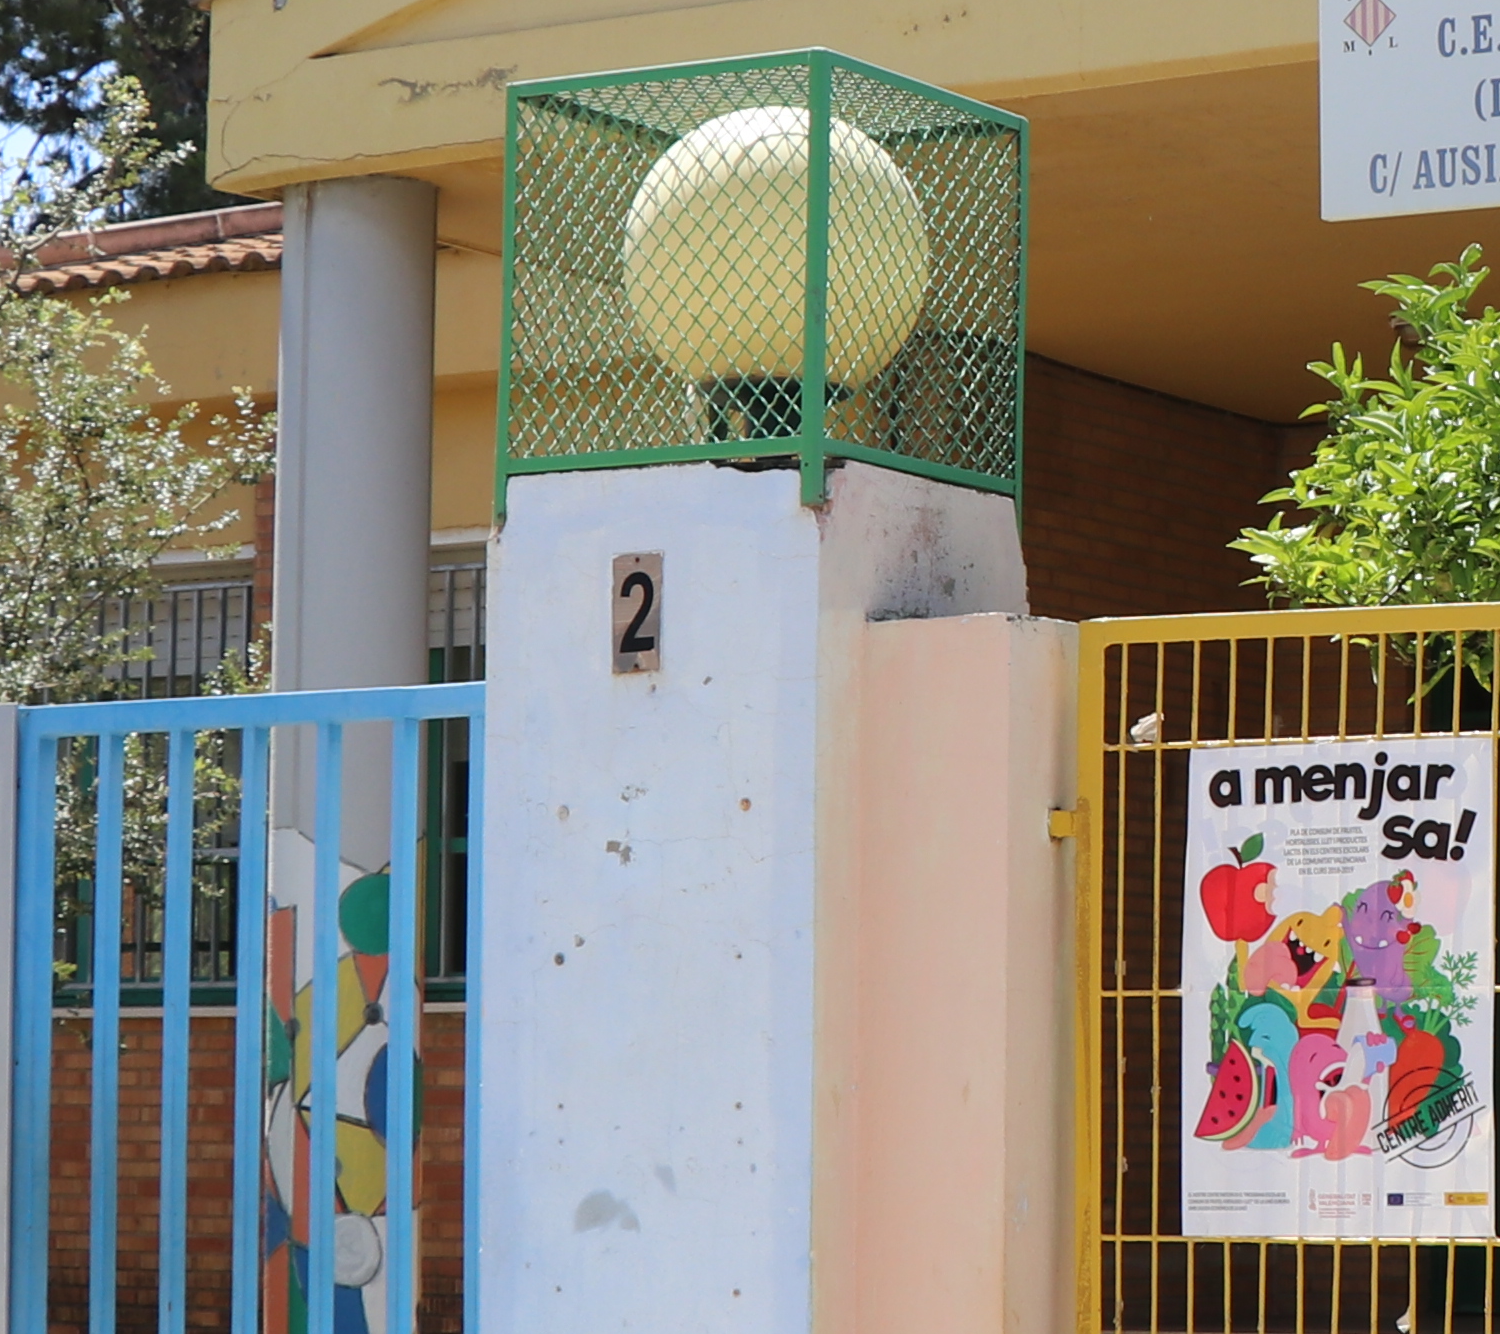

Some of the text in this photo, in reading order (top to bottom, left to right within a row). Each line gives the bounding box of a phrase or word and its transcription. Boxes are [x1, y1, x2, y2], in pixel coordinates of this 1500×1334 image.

[1343, 36, 1399, 53] M L
[1369, 151, 1402, 197] C/
[619, 571, 655, 653] 2
[1209, 751, 1455, 821] a menjar
[1381, 809, 1478, 861] sa!
[1377, 1080, 1479, 1154] CENTRE ADHERIT
